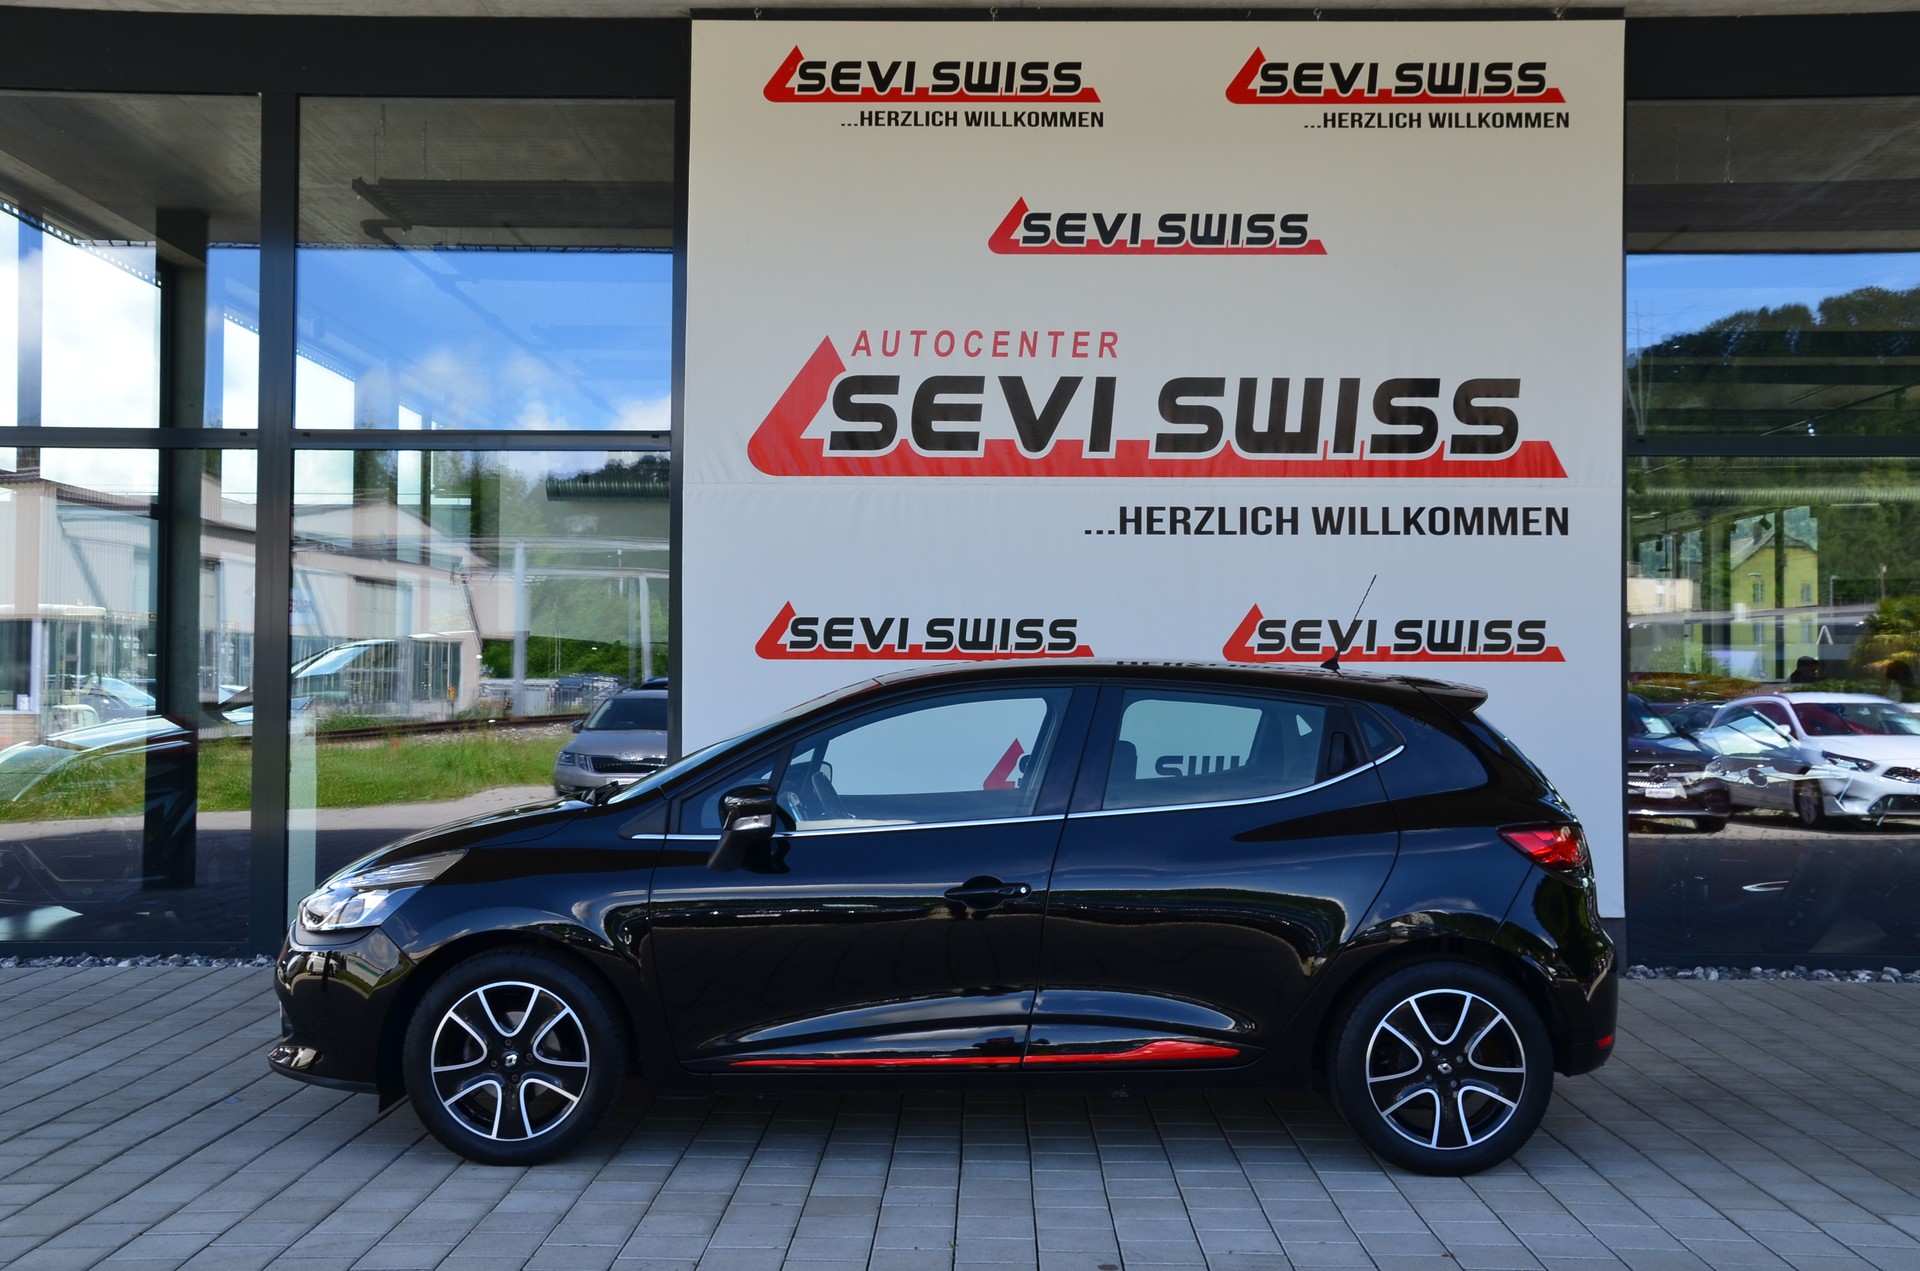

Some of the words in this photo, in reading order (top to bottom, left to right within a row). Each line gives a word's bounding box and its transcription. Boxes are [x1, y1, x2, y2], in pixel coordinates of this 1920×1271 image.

[797, 60, 916, 94] SEVI
[931, 61, 1083, 94] SWISS
[1259, 61, 1380, 95] SEVI
[1394, 61, 1548, 95] SWISS
[964, 110, 1105, 128] WILLKOMMEN
[1428, 112, 1570, 129] WILLKOMMEN
[1021, 212, 1142, 245] SEVI
[1156, 212, 1309, 246] SWISS
[851, 329, 1120, 359] AUTOCENTER
[828, 375, 1118, 453] SEVI
[1153, 376, 1522, 455] SWISS
[1311, 506, 1570, 536] WILLKOMMEN
[788, 617, 910, 650] SEVI
[924, 617, 1078, 651] SWISS
[1256, 618, 1378, 652] SEVI
[1392, 619, 1547, 653] SWISS
